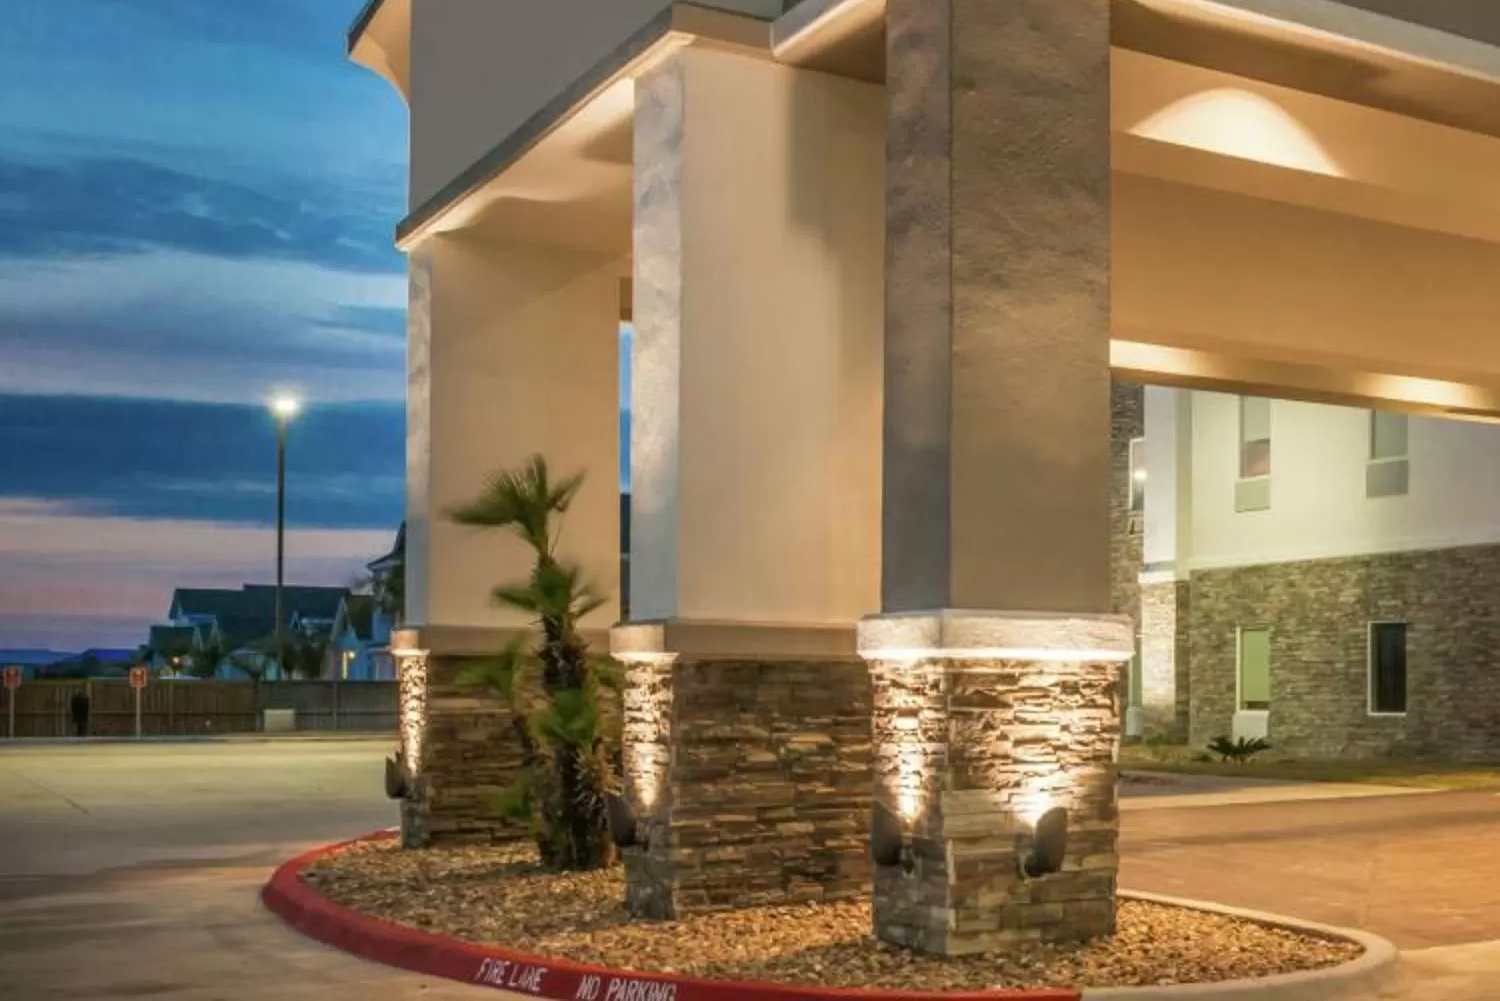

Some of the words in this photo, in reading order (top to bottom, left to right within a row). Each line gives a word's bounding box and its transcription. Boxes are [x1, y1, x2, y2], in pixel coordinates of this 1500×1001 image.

[474, 957, 511, 984] FIRE
[508, 965, 548, 992] LANE
[575, 974, 602, 1000] NO
[604, 977, 678, 1001] PARKING
